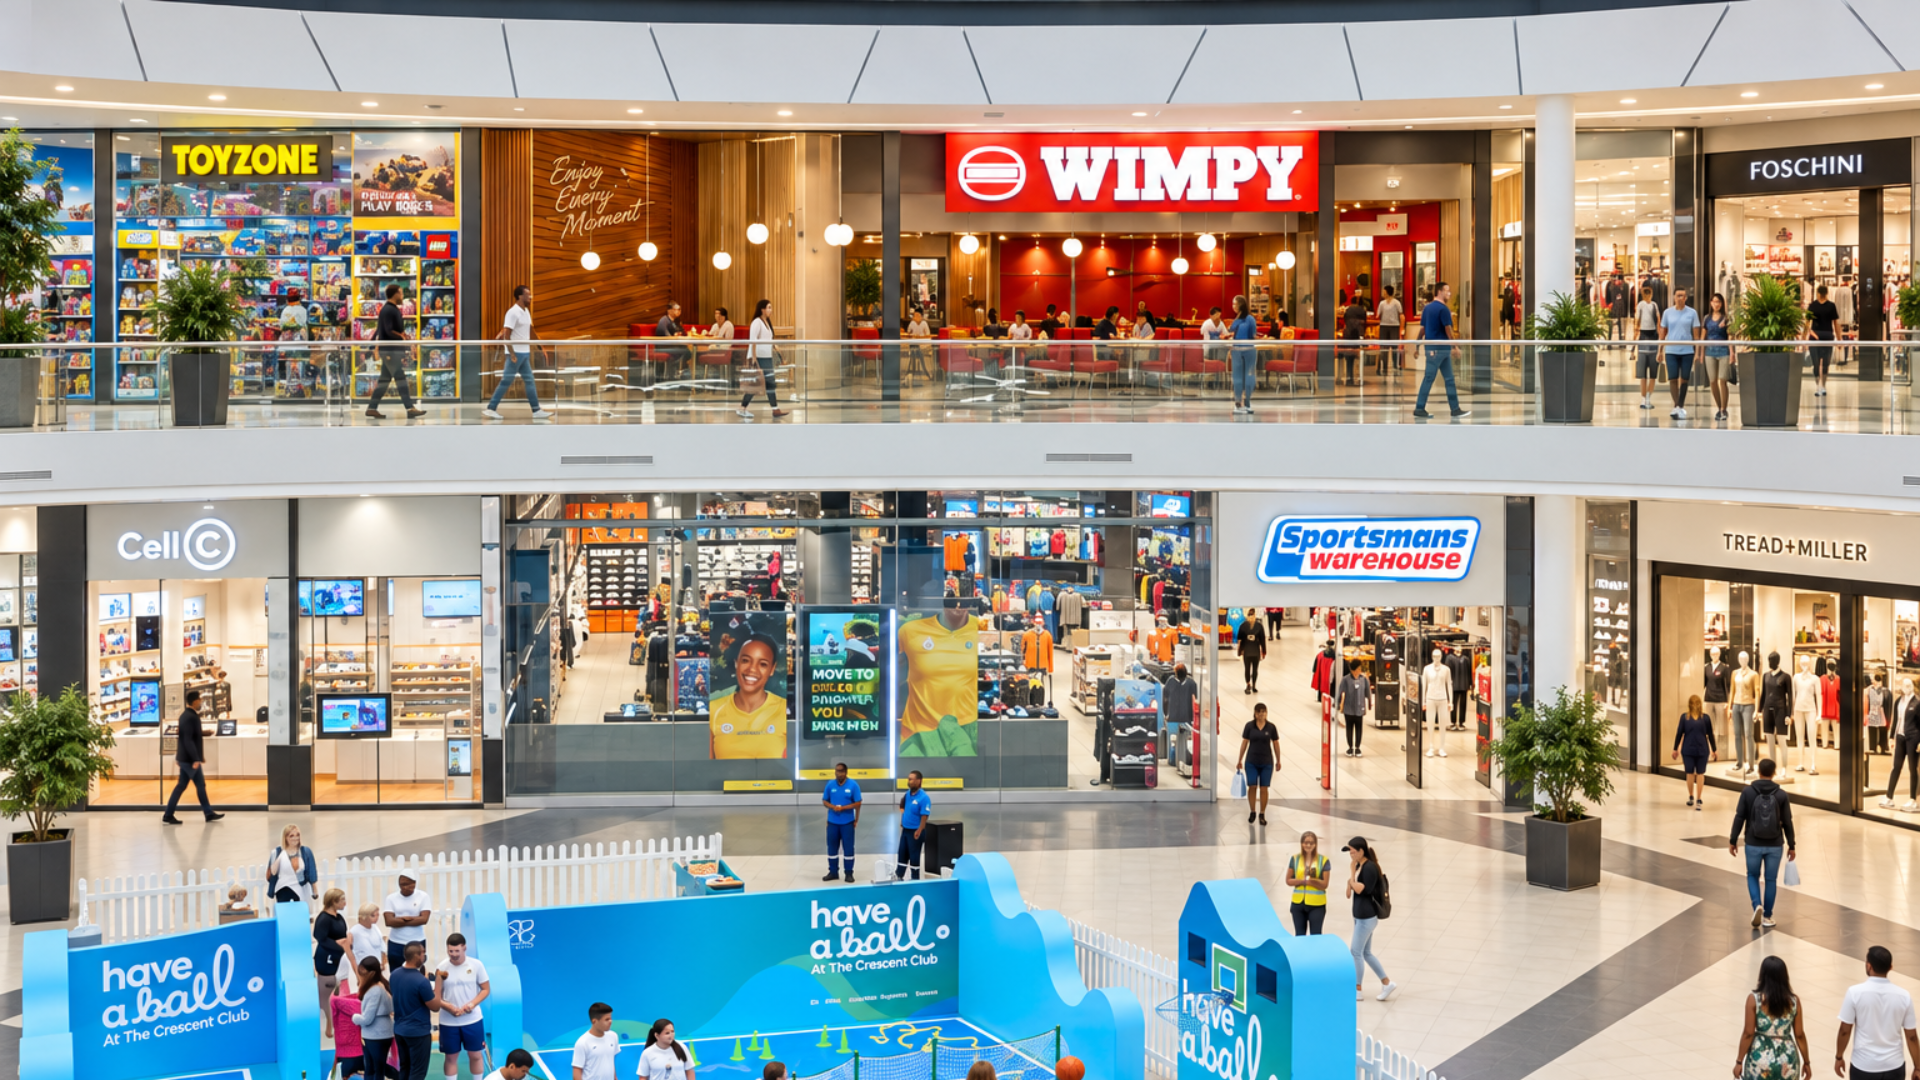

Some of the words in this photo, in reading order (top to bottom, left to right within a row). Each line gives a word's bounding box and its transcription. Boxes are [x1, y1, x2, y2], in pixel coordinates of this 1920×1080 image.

[172, 143, 319, 176] TOYZONE
[549, 154, 604, 192] Enjoy
[1040, 146, 1303, 201] WIMPY
[1750, 153, 1863, 181] FOSCHINI
[560, 198, 655, 240] Moment
[117, 530, 180, 560] Cell
[1281, 525, 1469, 553] Sportsmans
[1723, 532, 1868, 562] TREAD+MILLER
[812, 668, 853, 680] MOVE
[855, 668, 875, 680] TO
[811, 706, 844, 718] YOU
[810, 899, 891, 929] have
[810, 939, 833, 960] a
[810, 963, 826, 975] At
[828, 961, 853, 973] The
[855, 956, 908, 971] Crescent
[910, 953, 938, 967] Club
[102, 956, 193, 993] have
[102, 1004, 128, 1029] a
[1182, 978, 1235, 1037] have
[103, 1033, 120, 1048] At
[123, 1028, 151, 1044] The
[153, 1015, 215, 1039] Crescent
[217, 1008, 250, 1025] Club
[1182, 1030, 1197, 1063] a
